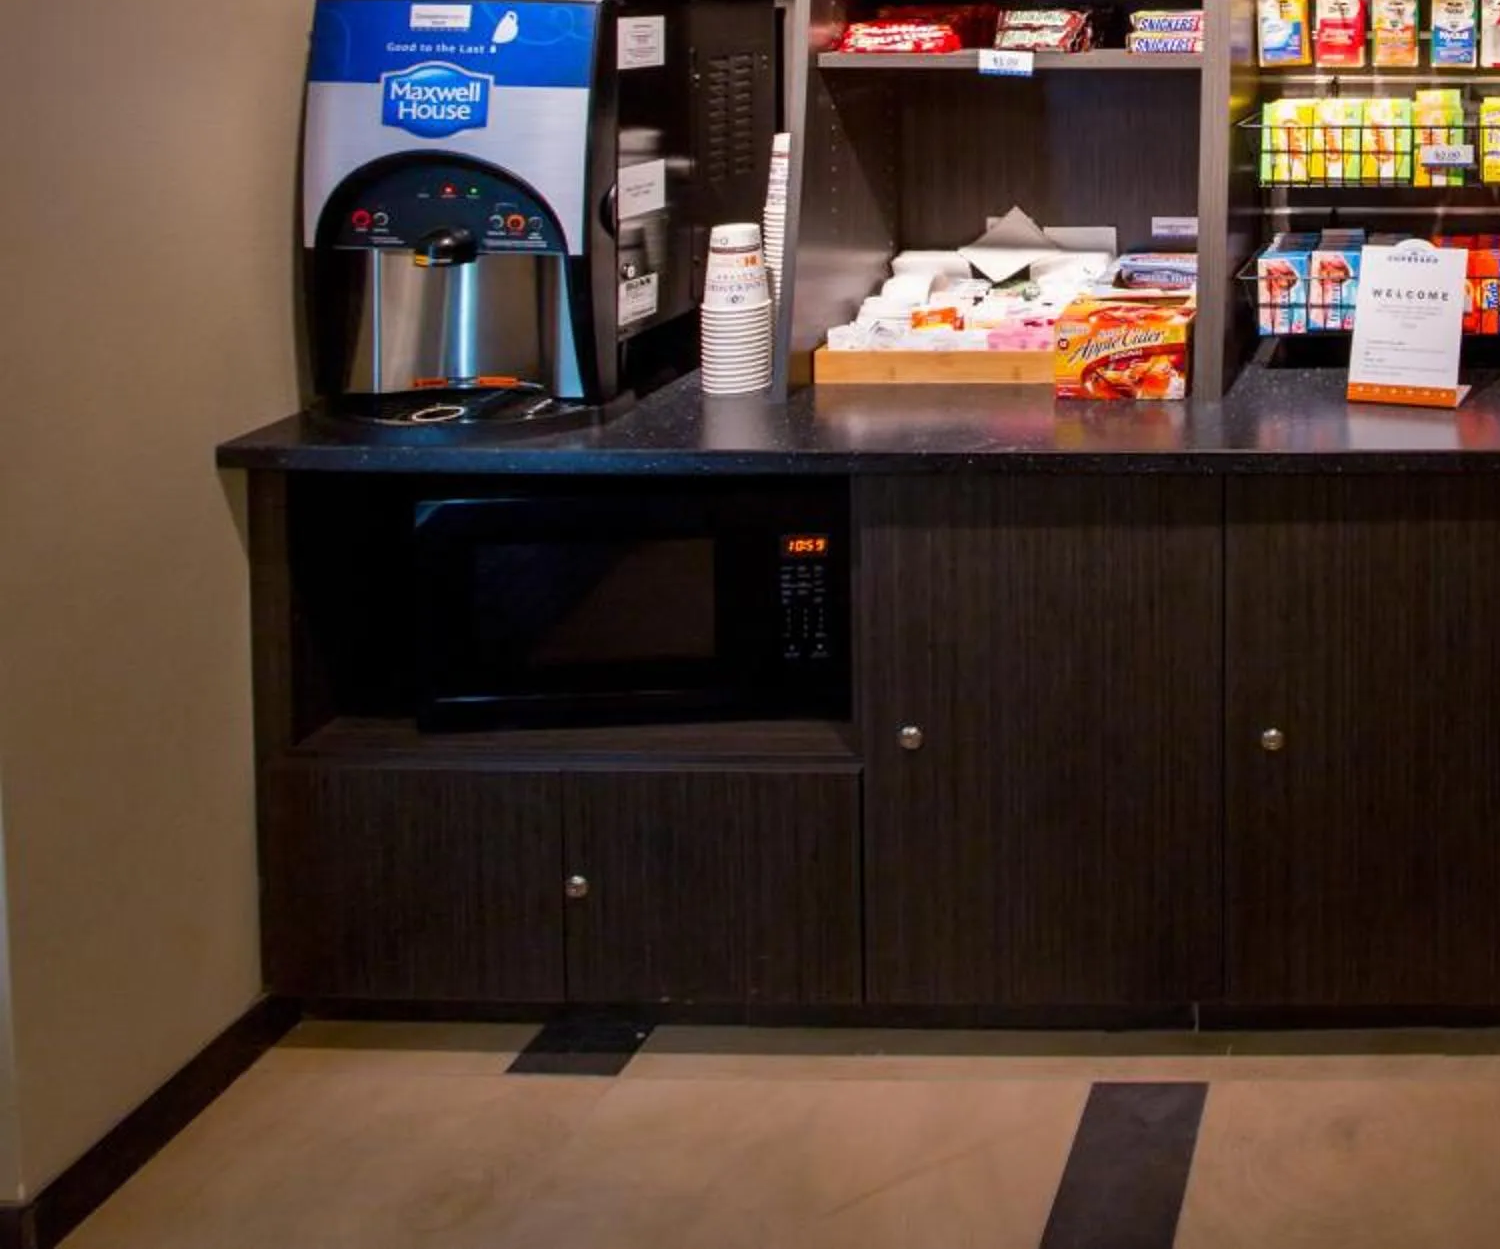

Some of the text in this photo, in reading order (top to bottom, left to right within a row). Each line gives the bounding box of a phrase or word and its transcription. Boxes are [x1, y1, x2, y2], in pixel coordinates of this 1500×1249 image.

[1140, 17, 1195, 33] SNICKERS
[420, 42, 434, 54] to
[436, 42, 456, 54] the
[390, 80, 481, 103] Maxwell
[398, 101, 472, 121] House
[1372, 288, 1449, 302] WELCOME
